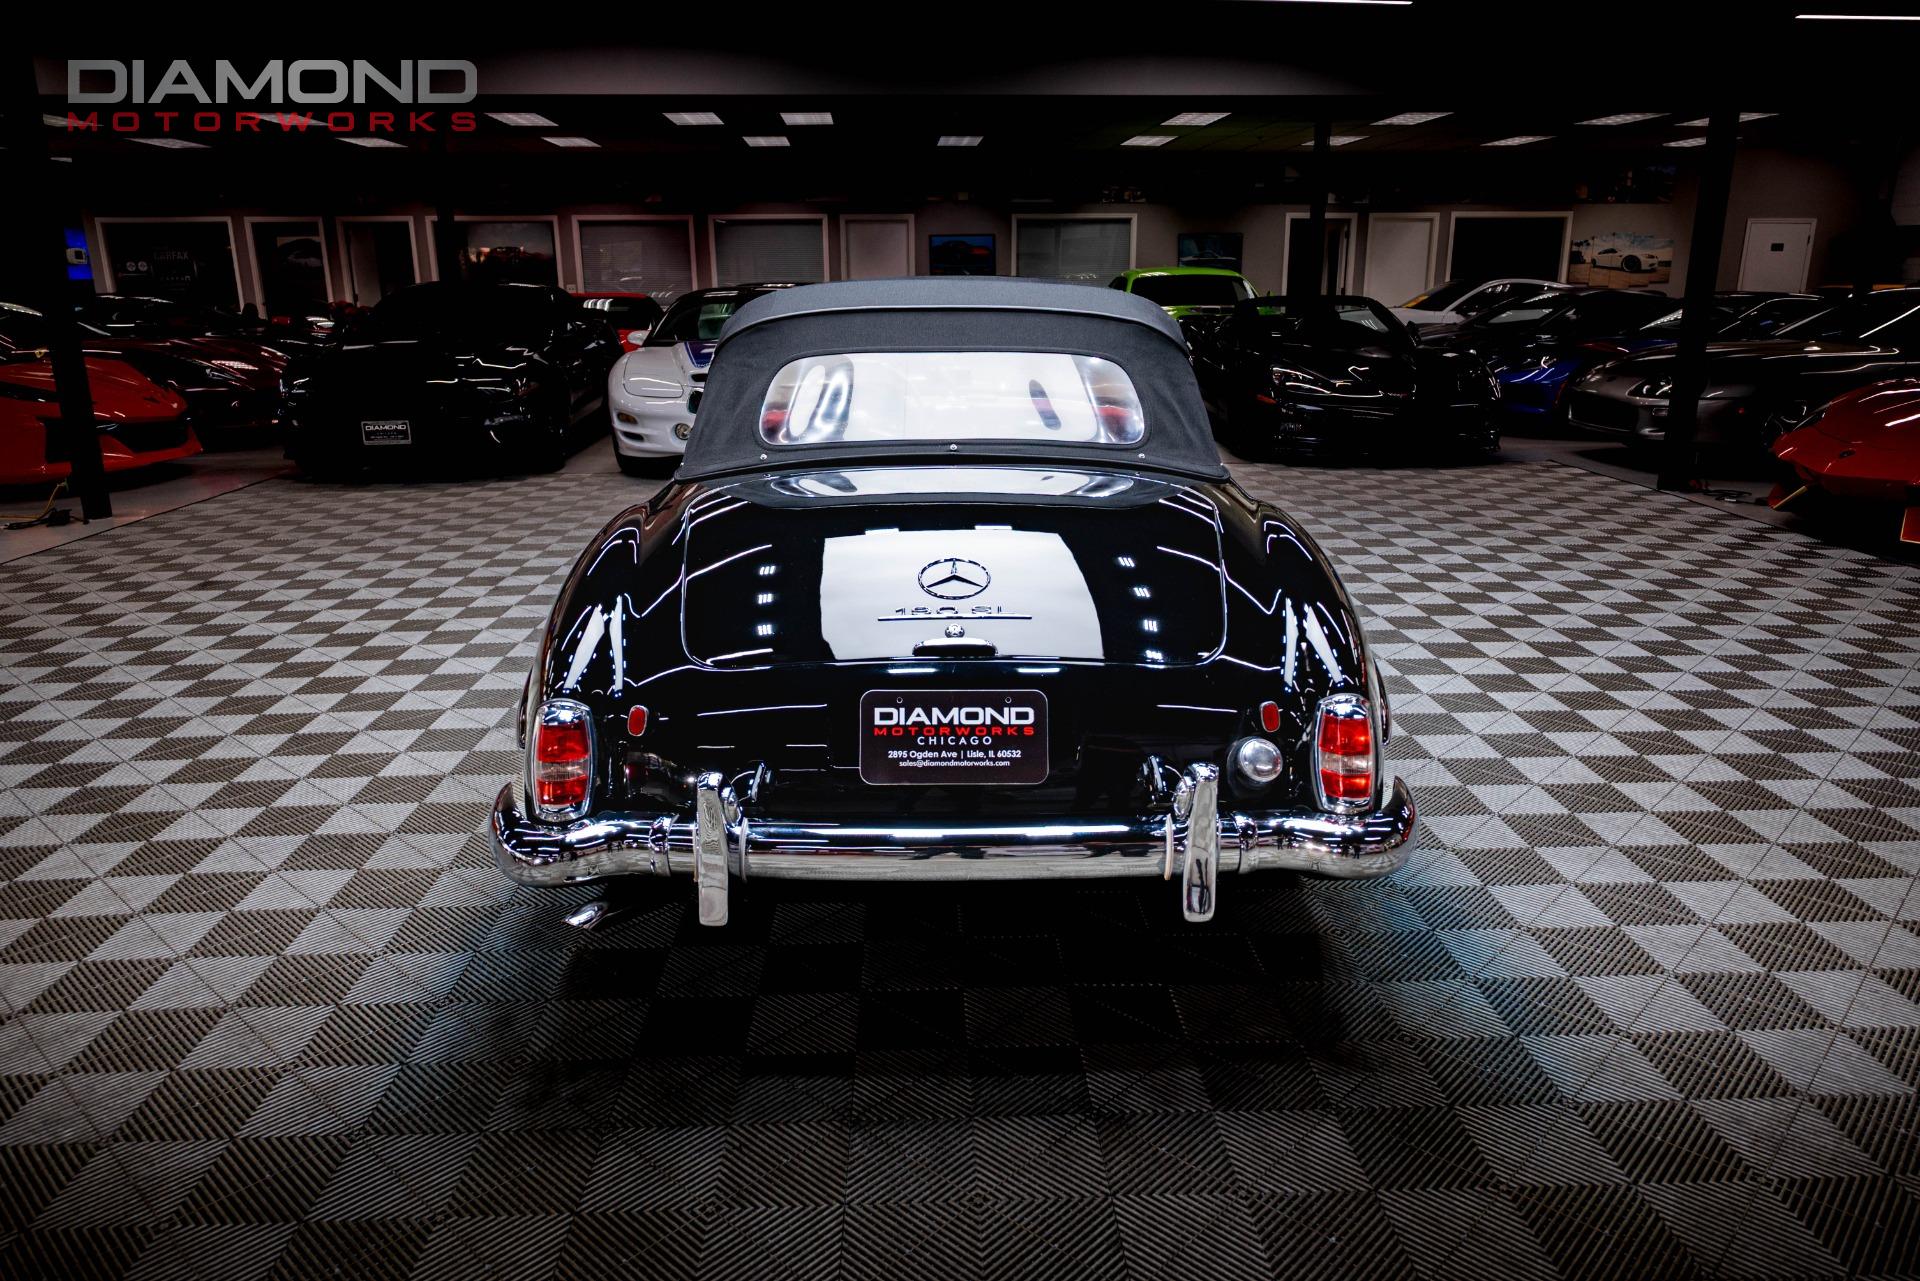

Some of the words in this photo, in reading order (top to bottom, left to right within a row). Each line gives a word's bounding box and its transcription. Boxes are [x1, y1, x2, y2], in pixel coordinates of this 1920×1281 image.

[874, 707, 1035, 725] DIAMOND
[874, 727, 1035, 736] MOTORWORKS
[917, 737, 992, 745] CHICAGO
[888, 750, 907, 758] 2895
[909, 750, 939, 760] Ogden
[940, 750, 958, 758] Ave
[967, 750, 987, 759] Lisle,
[988, 750, 996, 758] IL
[997, 750, 1021, 758] 60532
